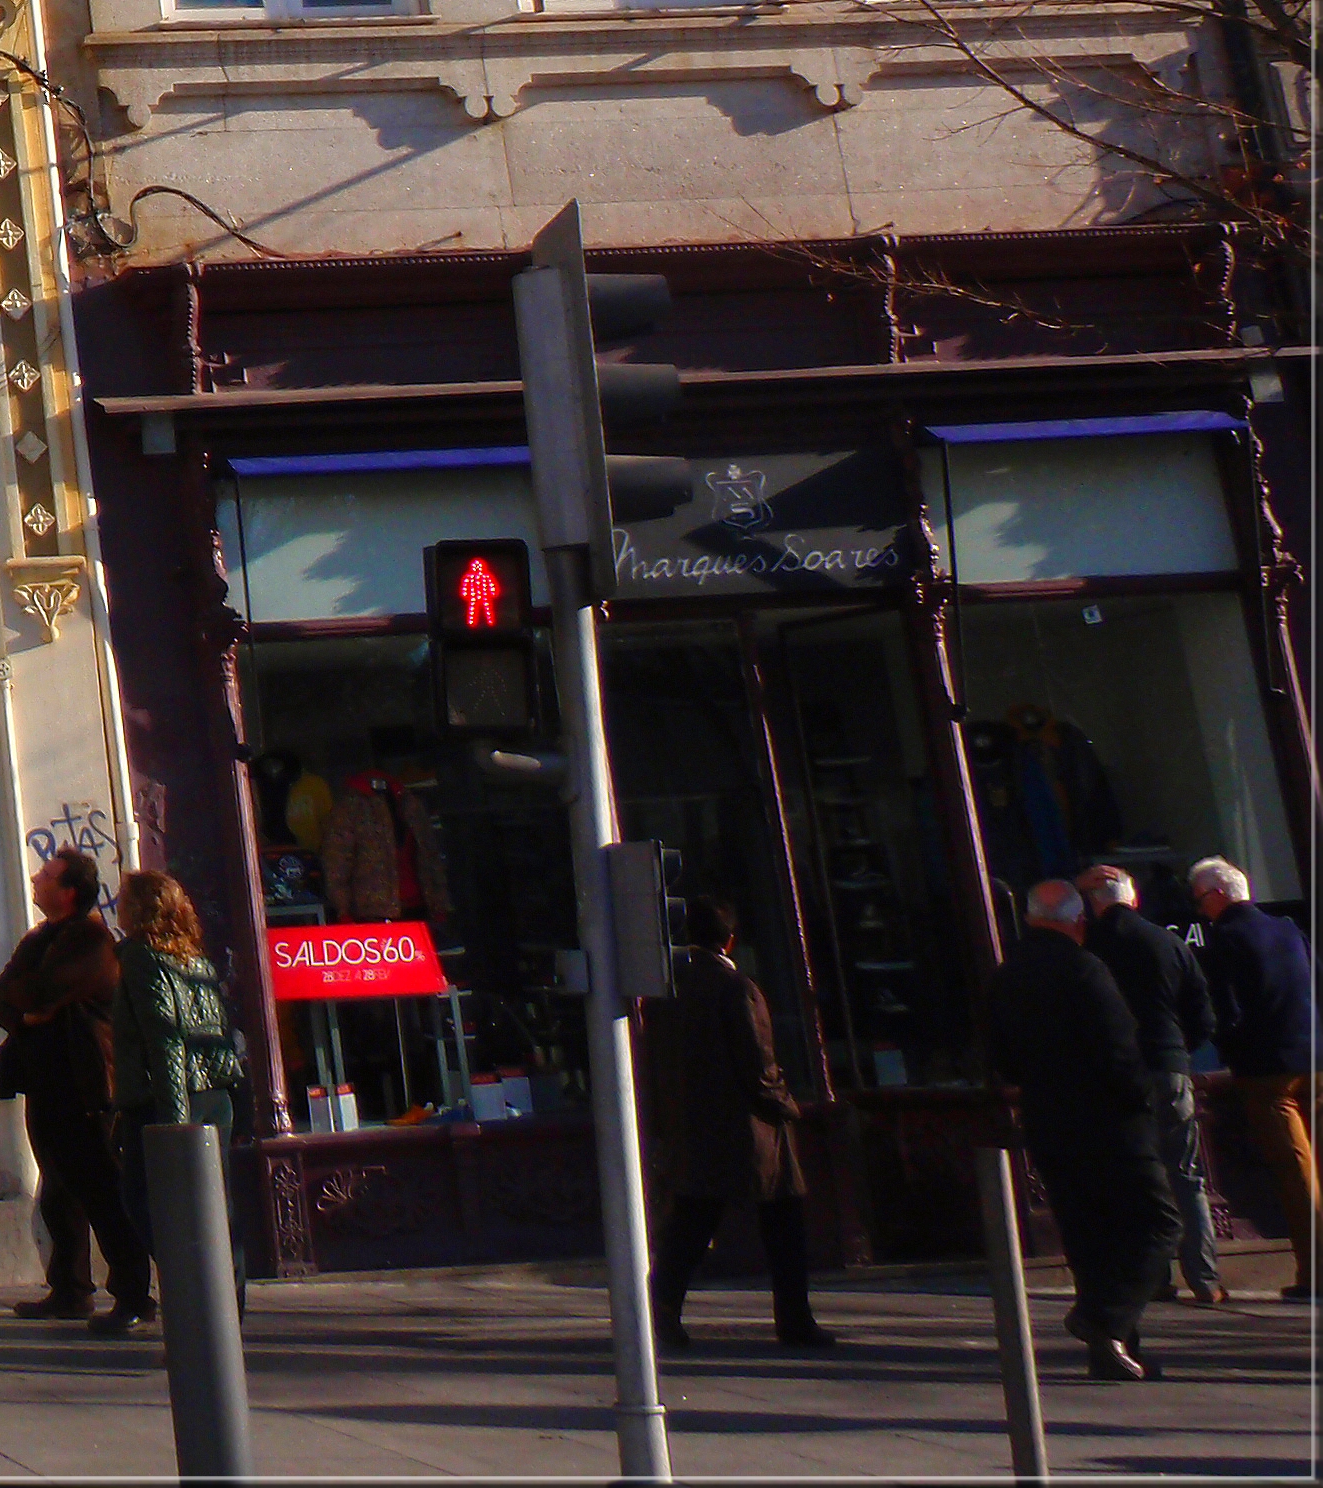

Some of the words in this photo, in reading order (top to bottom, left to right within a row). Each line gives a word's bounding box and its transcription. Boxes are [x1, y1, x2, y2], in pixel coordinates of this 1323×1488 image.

[613, 528, 767, 586] Marques
[769, 533, 900, 573] Soares
[275, 936, 382, 969] SALDOS
